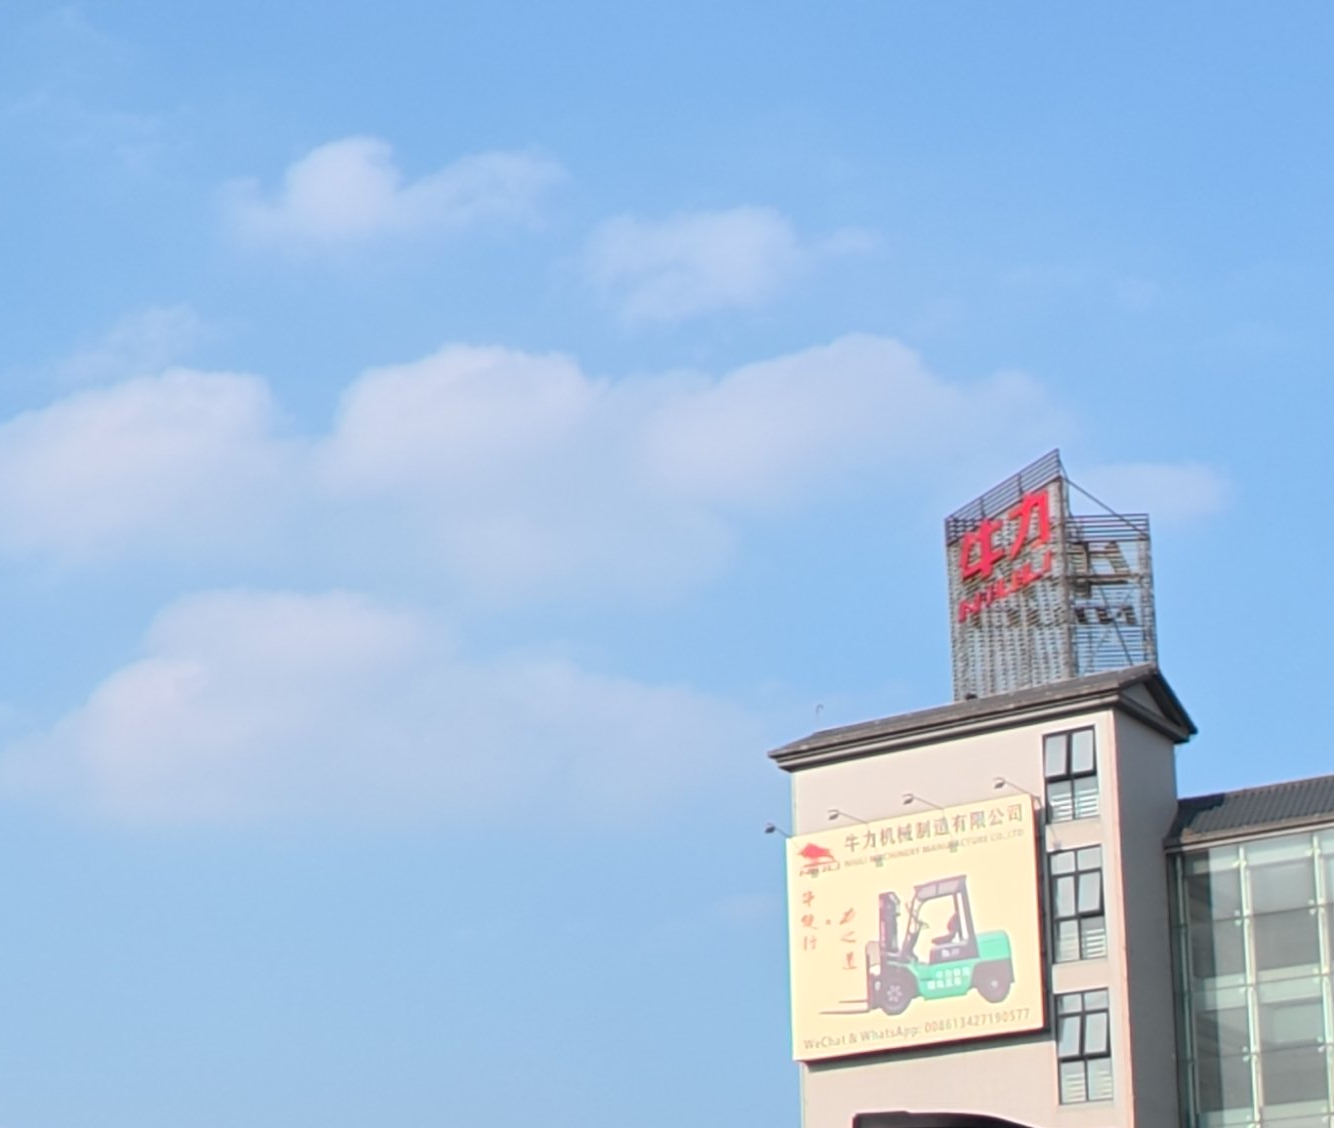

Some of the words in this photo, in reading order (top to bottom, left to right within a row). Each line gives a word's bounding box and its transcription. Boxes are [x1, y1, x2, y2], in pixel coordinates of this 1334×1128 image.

[959, 488, 1051, 581] 牛力
[844, 804, 1024, 852] 牛力机械制造有限公司
[803, 1036, 846, 1050] WeChat
